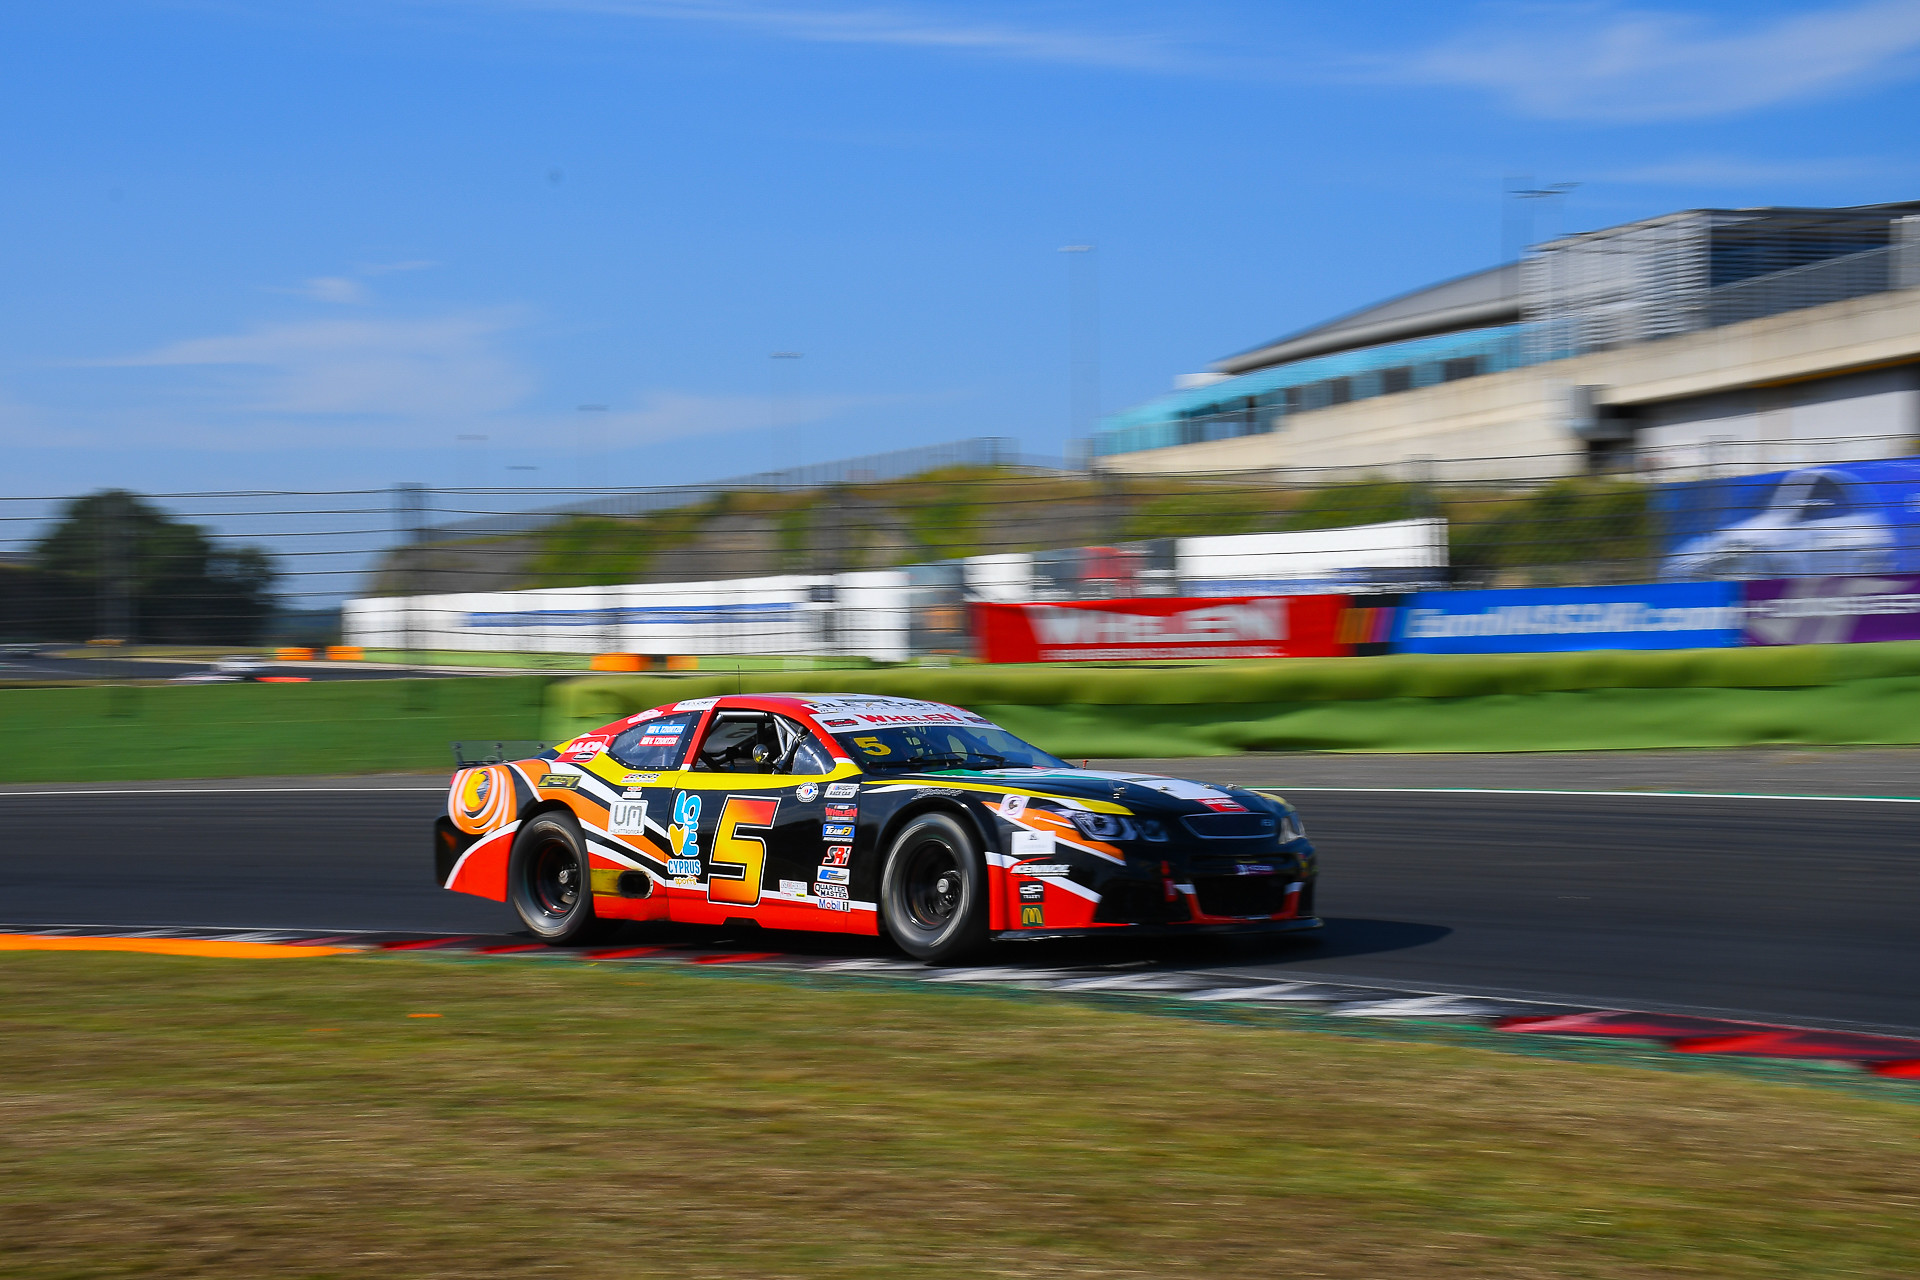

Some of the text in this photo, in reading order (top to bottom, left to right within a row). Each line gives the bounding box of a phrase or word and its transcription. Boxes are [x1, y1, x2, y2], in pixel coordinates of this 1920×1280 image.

[1024, 600, 1288, 643] WHELEN
[854, 713, 963, 723] WHELEN
[853, 736, 891, 756] 5
[825, 806, 858, 818] WHELEN
[707, 794, 781, 907] 5
[667, 859, 701, 875] CYPRUS
[673, 876, 697, 887] sports
[815, 883, 846, 893] QUARTER
[820, 890, 847, 898] MASTER
[819, 899, 849, 911] Mobil 1
